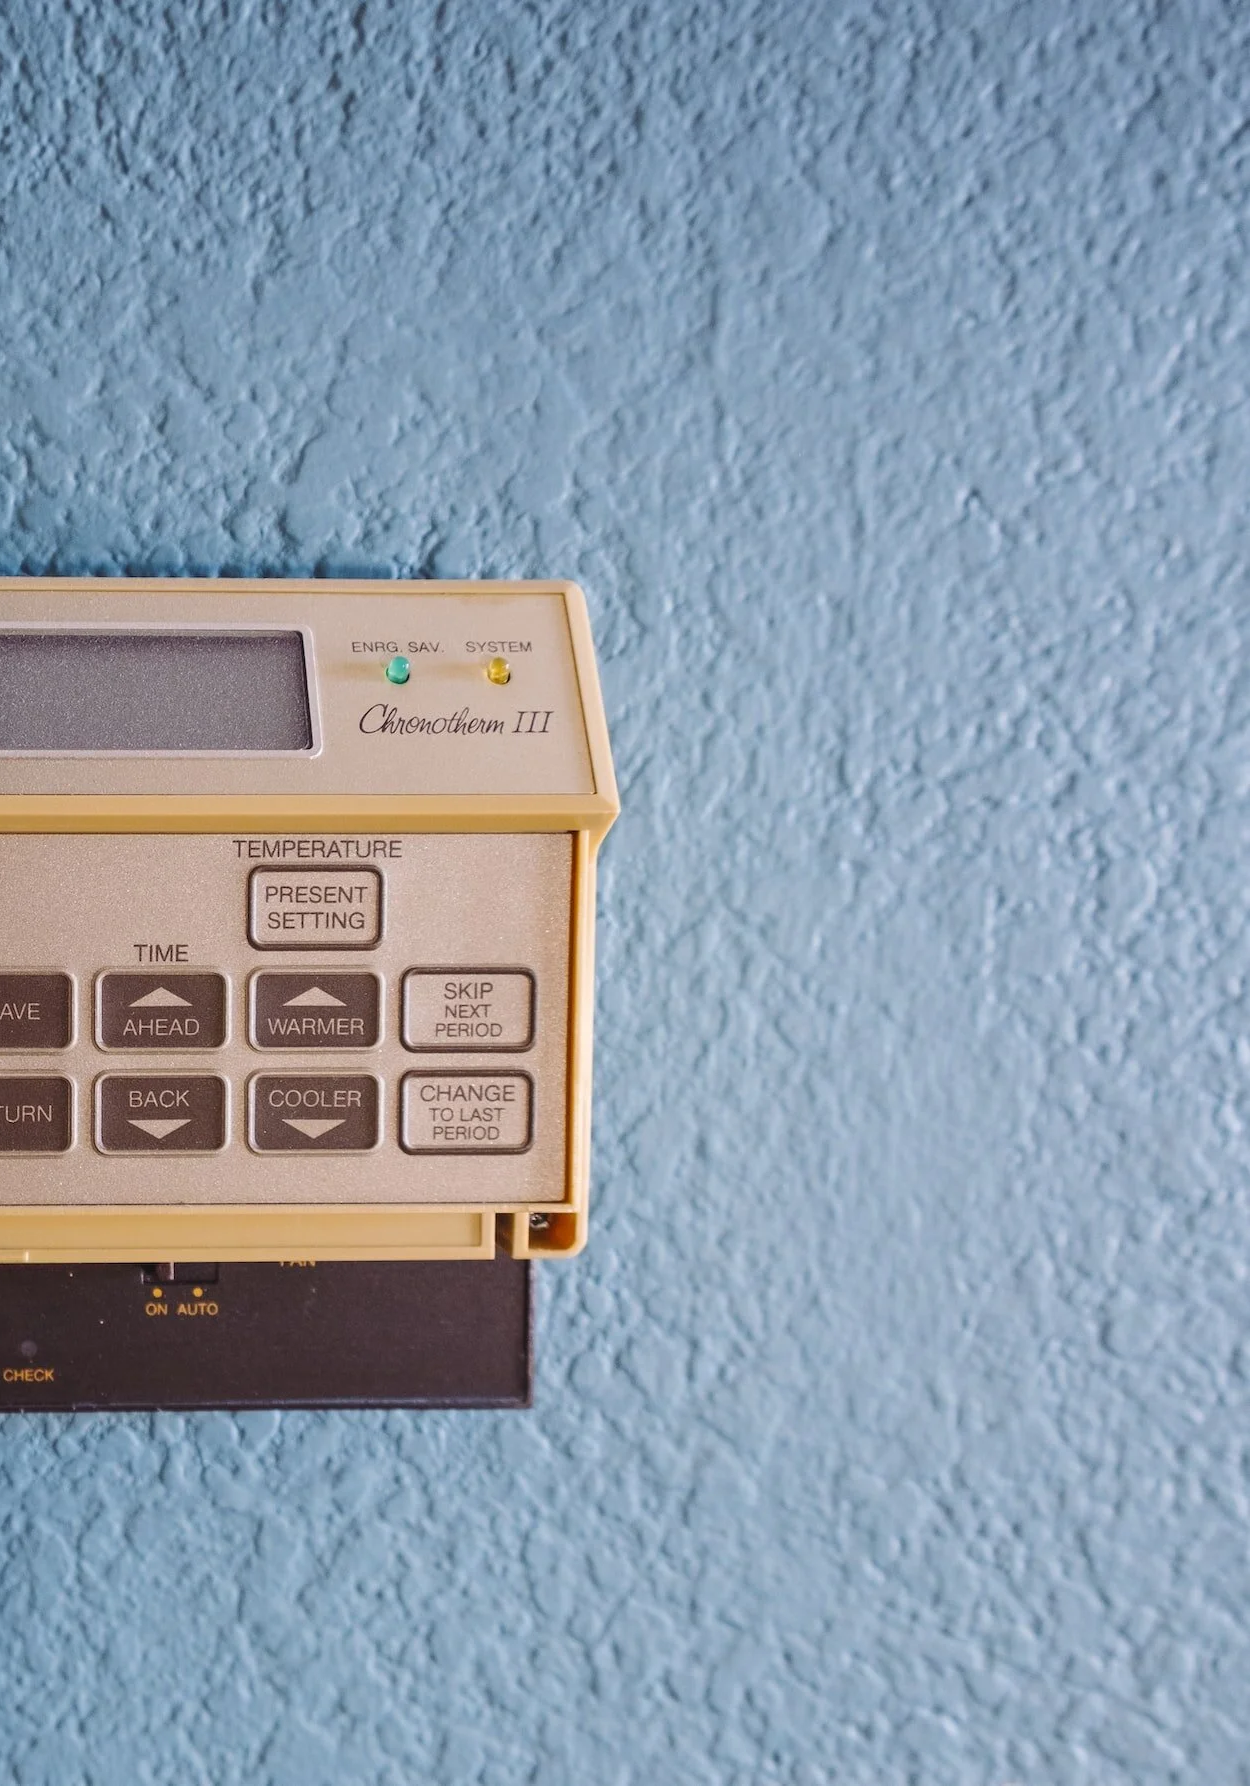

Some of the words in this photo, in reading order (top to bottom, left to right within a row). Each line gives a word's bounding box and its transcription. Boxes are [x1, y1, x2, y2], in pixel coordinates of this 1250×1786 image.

[352, 642, 402, 653] ENRG.
[408, 642, 444, 652] SAV.
[465, 641, 532, 652] SYSTEM
[359, 703, 504, 735] Chronotherm
[512, 711, 554, 733] III
[233, 840, 402, 858] TEMPERATURE
[265, 886, 368, 903] PRESENT
[267, 912, 365, 929] SETTING
[134, 944, 189, 962] TIME
[444, 982, 493, 999] SKIP
[445, 1004, 492, 1018] NEXT
[123, 1019, 200, 1036] AHEAD
[268, 1018, 365, 1035] WARMER
[435, 1023, 503, 1037] PERIOD
[129, 1090, 190, 1108] BACK
[269, 1090, 362, 1108] COOLER
[420, 1085, 515, 1102] CHANGE
[429, 1108, 454, 1121] TO
[460, 1108, 505, 1121] LAST
[433, 1126, 500, 1140] PERIOD
[145, 1303, 168, 1315] ON
[177, 1303, 218, 1315] AUTO
[3, 1368, 54, 1382] CHECK
